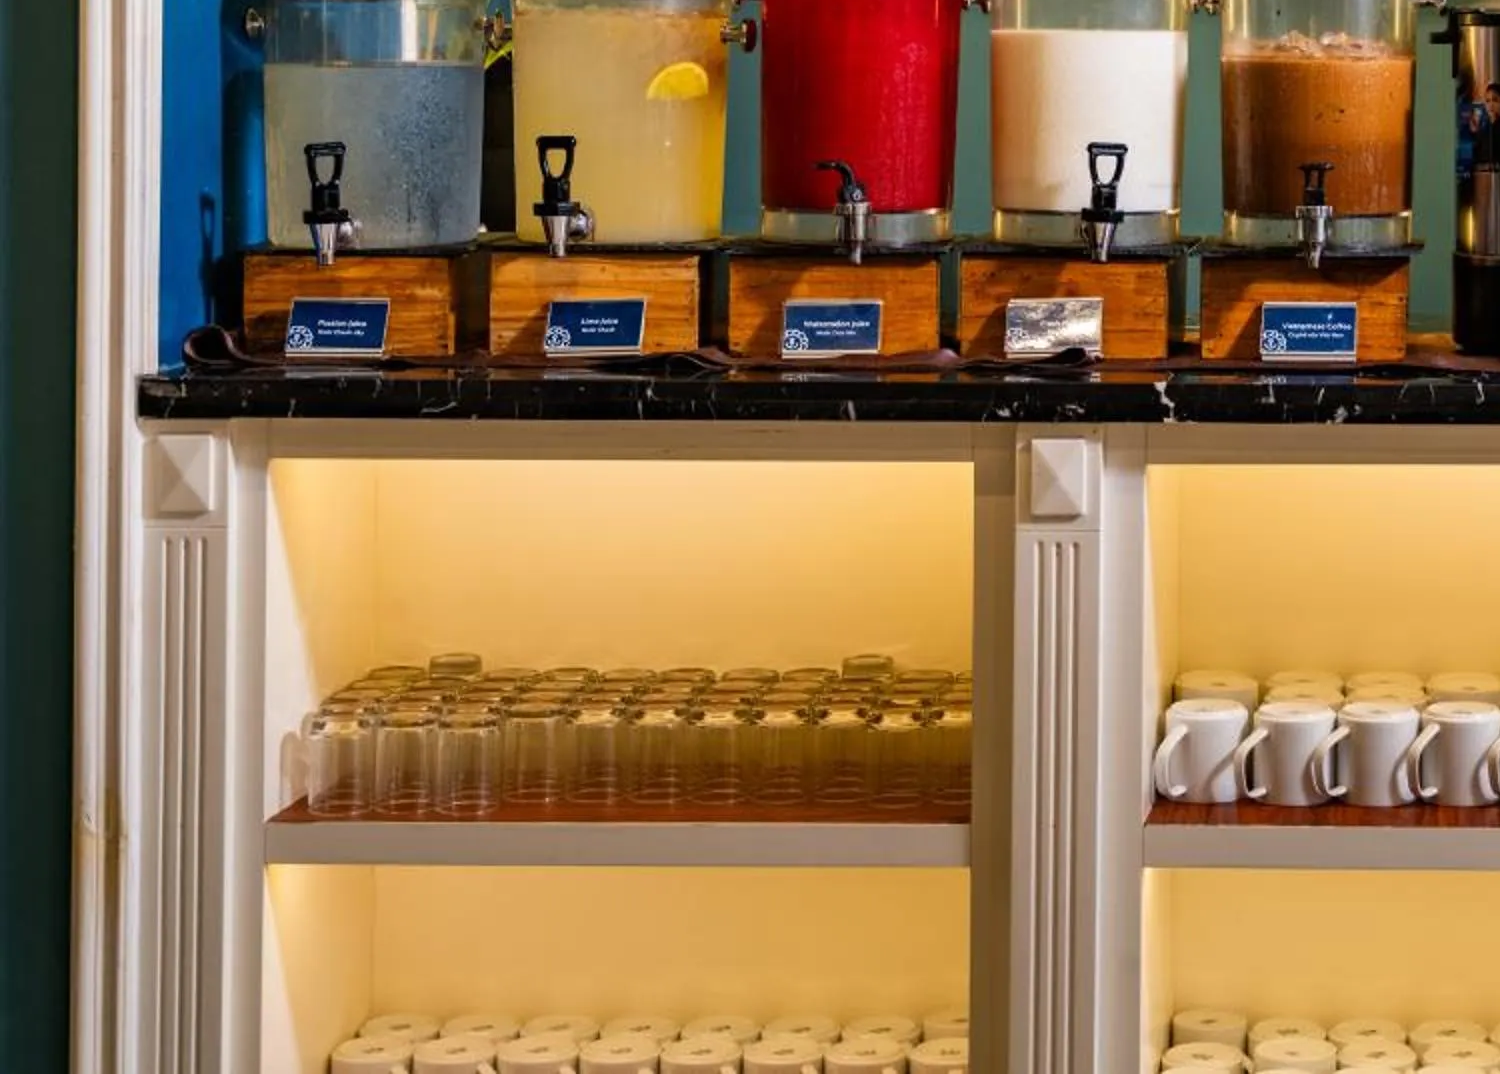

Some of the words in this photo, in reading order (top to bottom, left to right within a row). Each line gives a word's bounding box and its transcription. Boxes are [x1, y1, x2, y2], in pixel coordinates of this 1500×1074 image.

[600, 318, 619, 326] Juice
[1282, 322, 1325, 330] Vietnamese
[1326, 322, 1352, 330] Coffee
